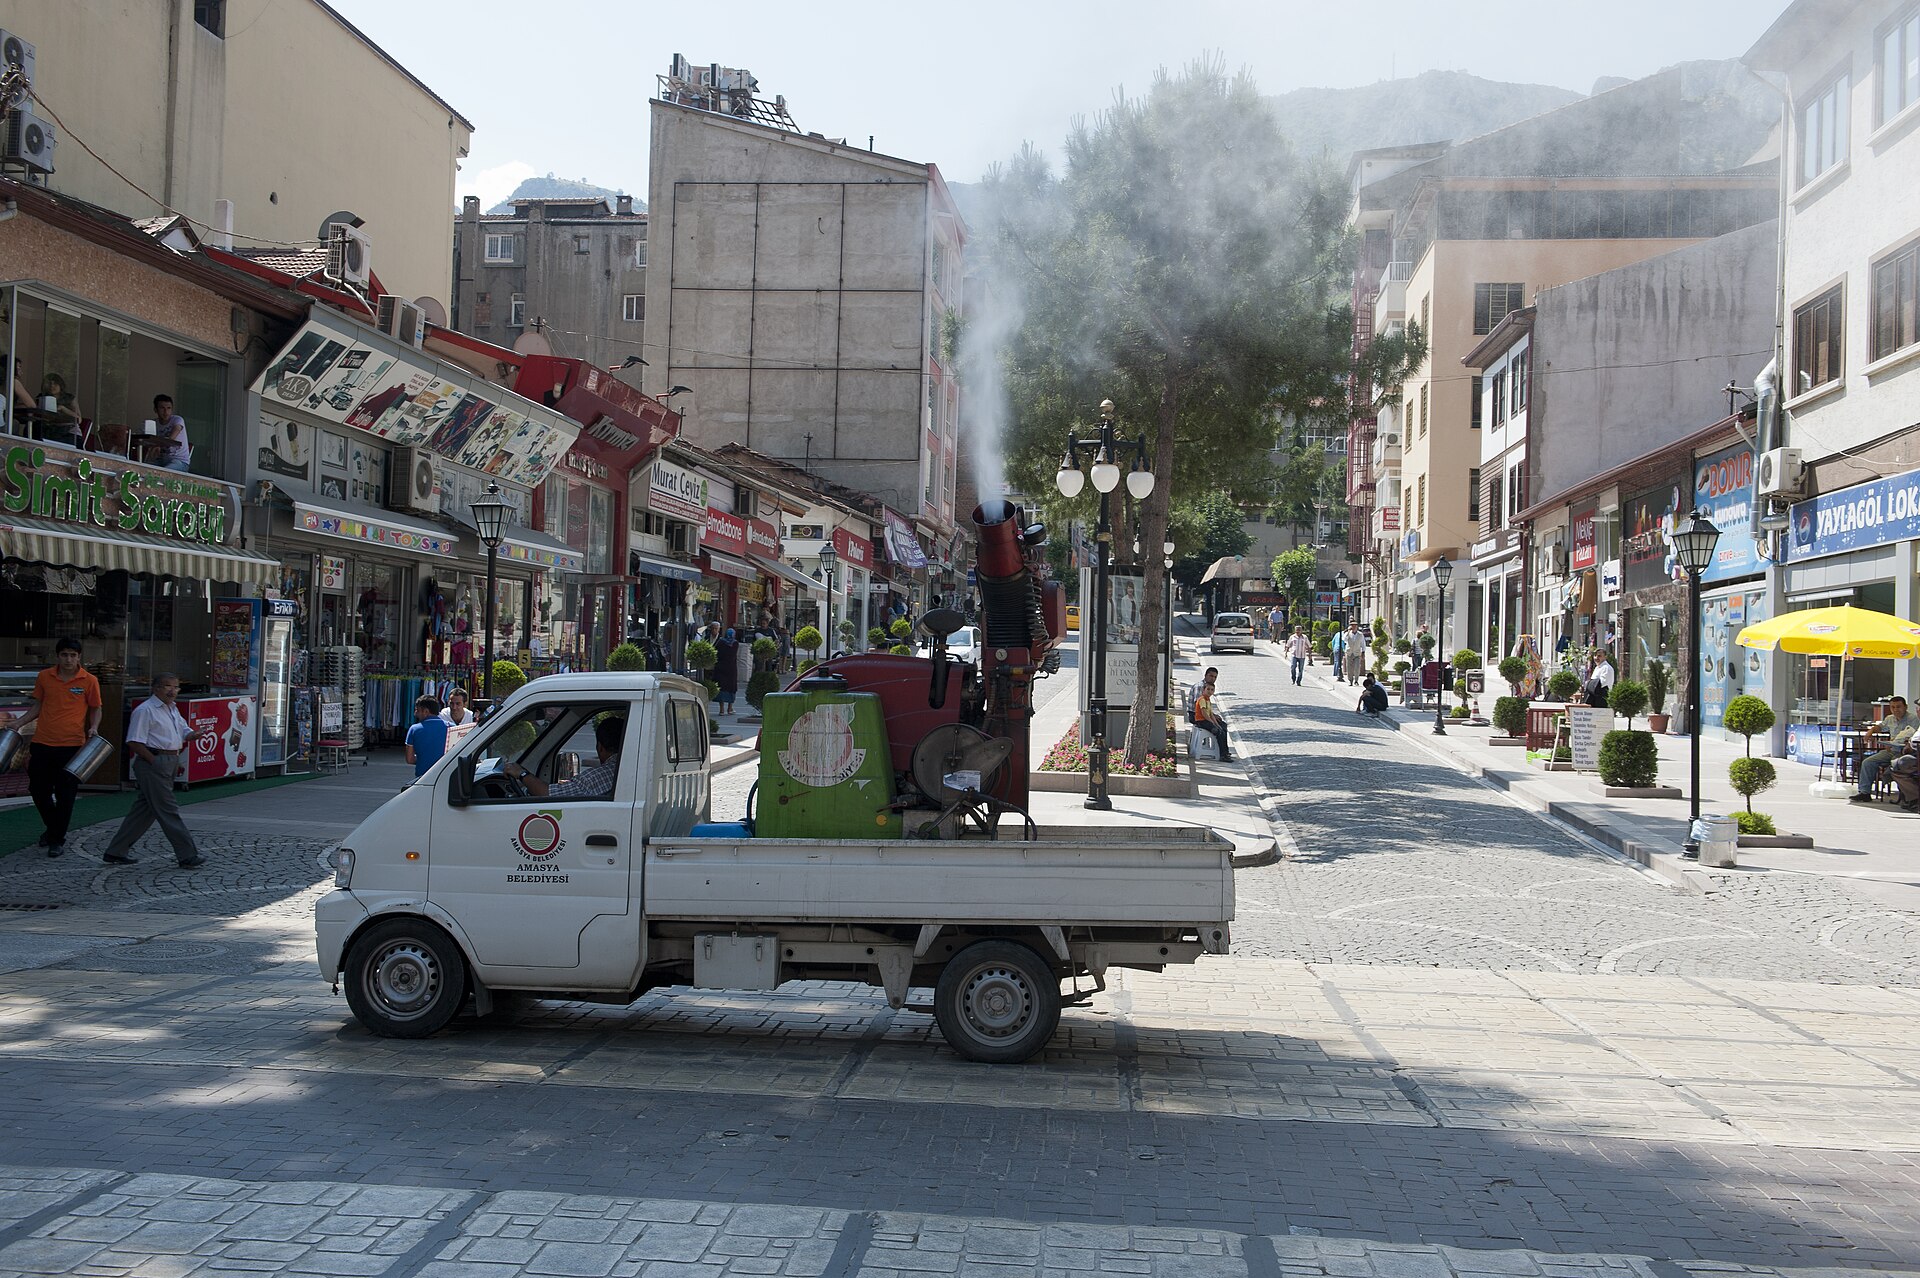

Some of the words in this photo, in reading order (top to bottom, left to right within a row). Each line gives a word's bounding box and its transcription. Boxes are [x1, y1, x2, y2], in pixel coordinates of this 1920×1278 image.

[281, 378, 309, 395] AKA
[651, 462, 677, 491] Murat
[680, 473, 700, 502] Çeyiz
[1710, 451, 1752, 498] BODUR
[4, 446, 106, 527] Simit
[118, 470, 225, 545] Sarayı
[1816, 488, 1884, 538] YAYLAGÖL
[1887, 485, 1920, 522] LOK
[390, 530, 430, 551] TOYS
[510, 837, 531, 861] AMASYA
[532, 839, 567, 862] BELEDİYESİ
[506, 873, 569, 883] BELEDİYESİ
[516, 863, 560, 872] AMASYA
